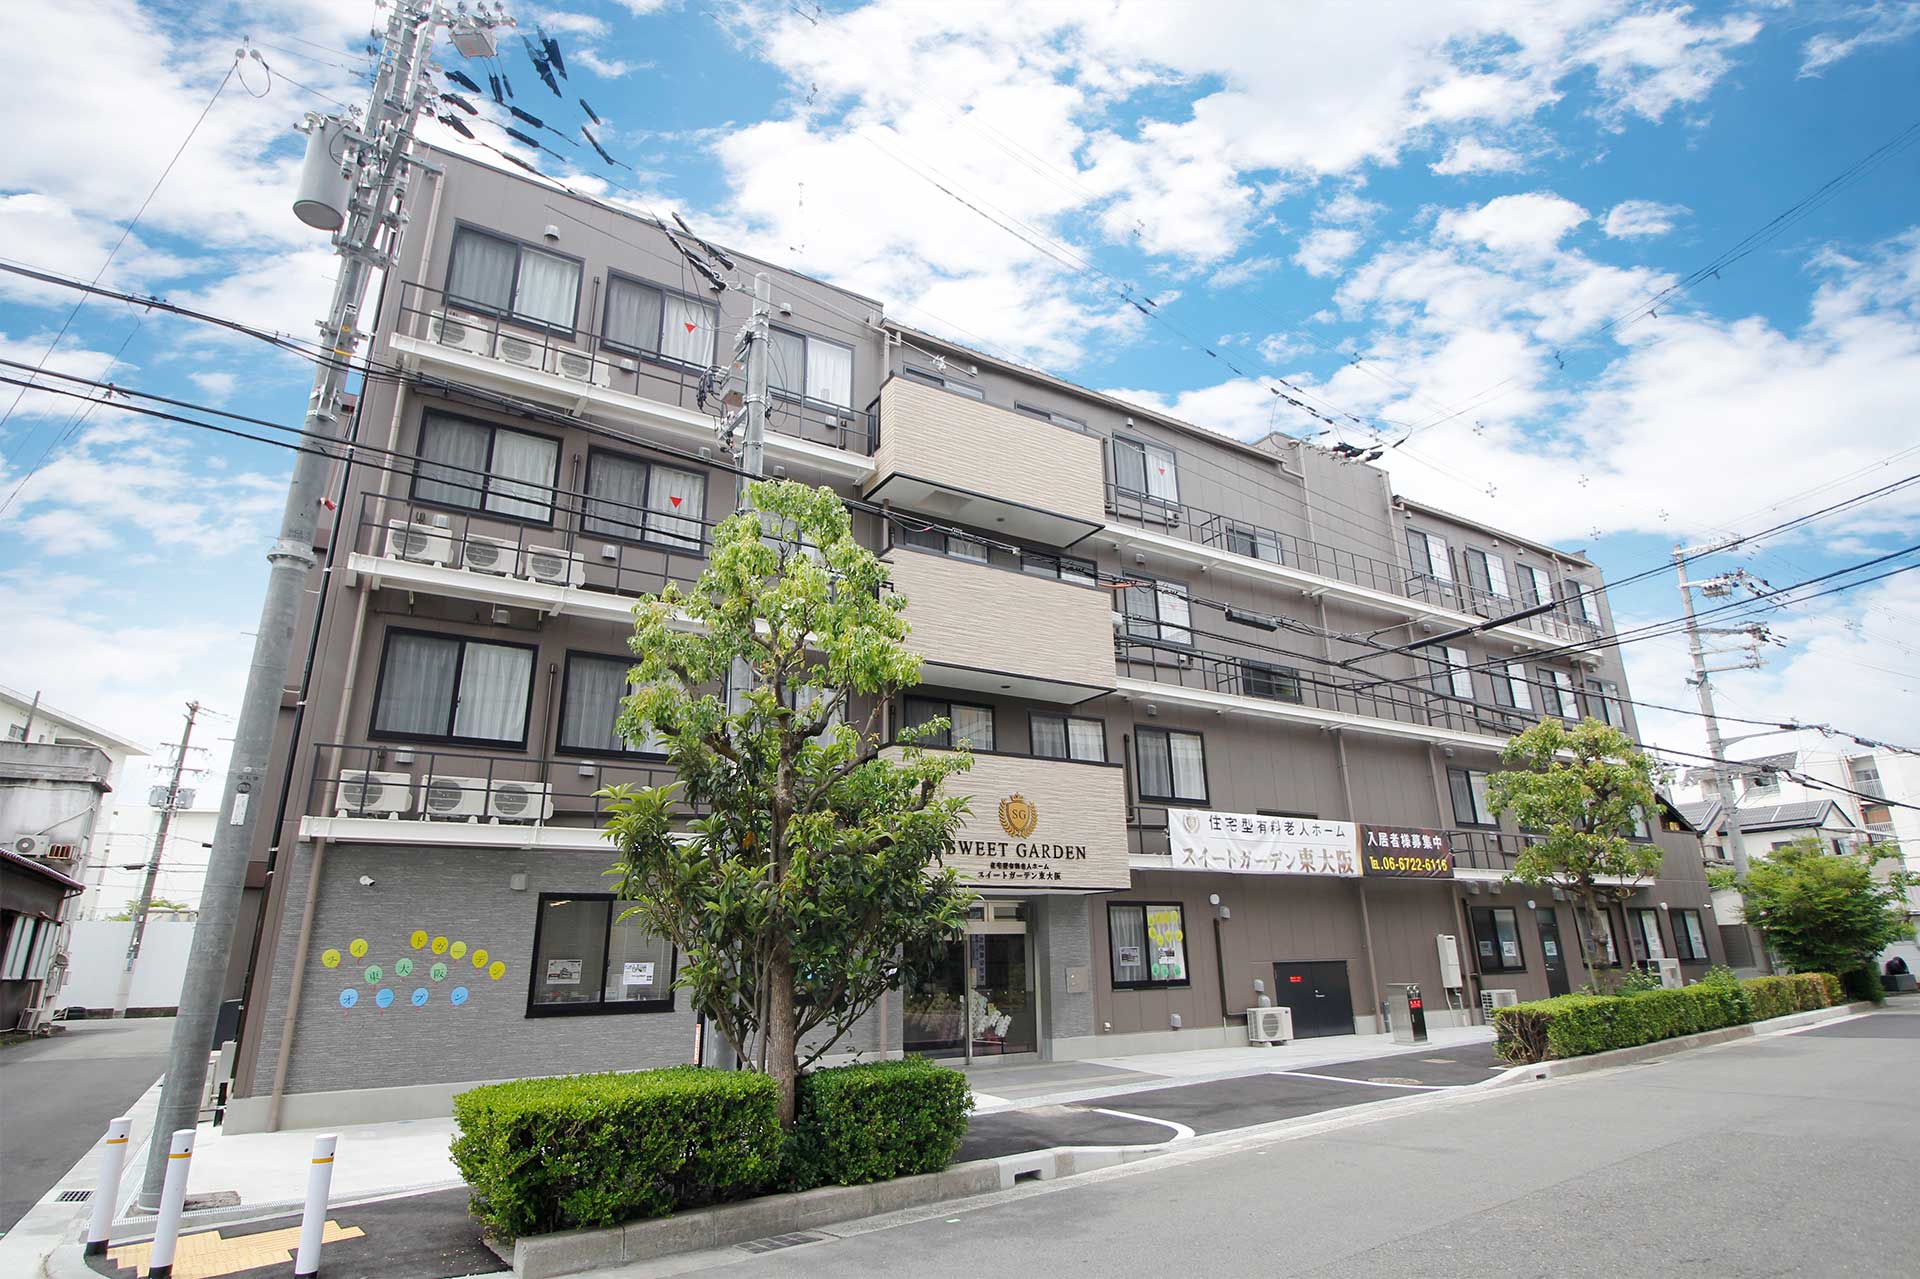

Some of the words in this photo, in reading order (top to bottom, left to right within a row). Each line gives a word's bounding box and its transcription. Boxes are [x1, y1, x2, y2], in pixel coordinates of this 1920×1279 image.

[1011, 809, 1027, 820] SG
[1209, 815, 1346, 838] 住宅型有料老人ホーム
[1367, 831, 1443, 850] 入居者様募集中
[1016, 843, 1087, 860] GARDEN
[1182, 847, 1355, 874] スイートガーデン東大阪
[978, 871, 1062, 881] スイートガーデン東大阪
